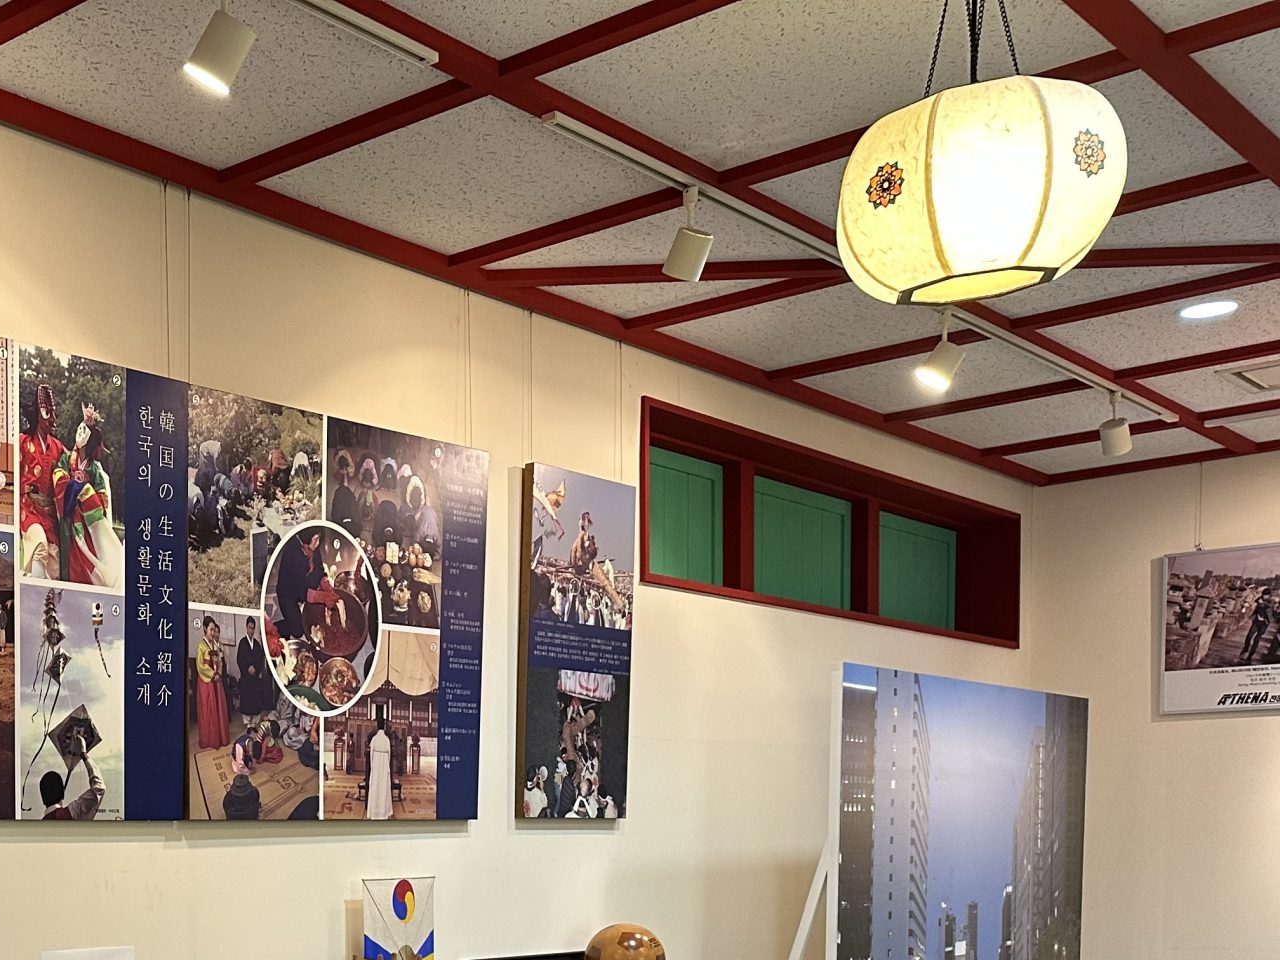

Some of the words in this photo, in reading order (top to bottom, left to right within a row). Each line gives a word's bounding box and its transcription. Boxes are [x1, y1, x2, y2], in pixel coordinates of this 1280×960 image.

[137, 405, 153, 487] 한국의
[136, 518, 152, 626] 생활문화
[156, 409, 175, 707] 韓国の生活文化紹介
[136, 656, 152, 706] 소개
[1217, 691, 1269, 705] ATHENA
